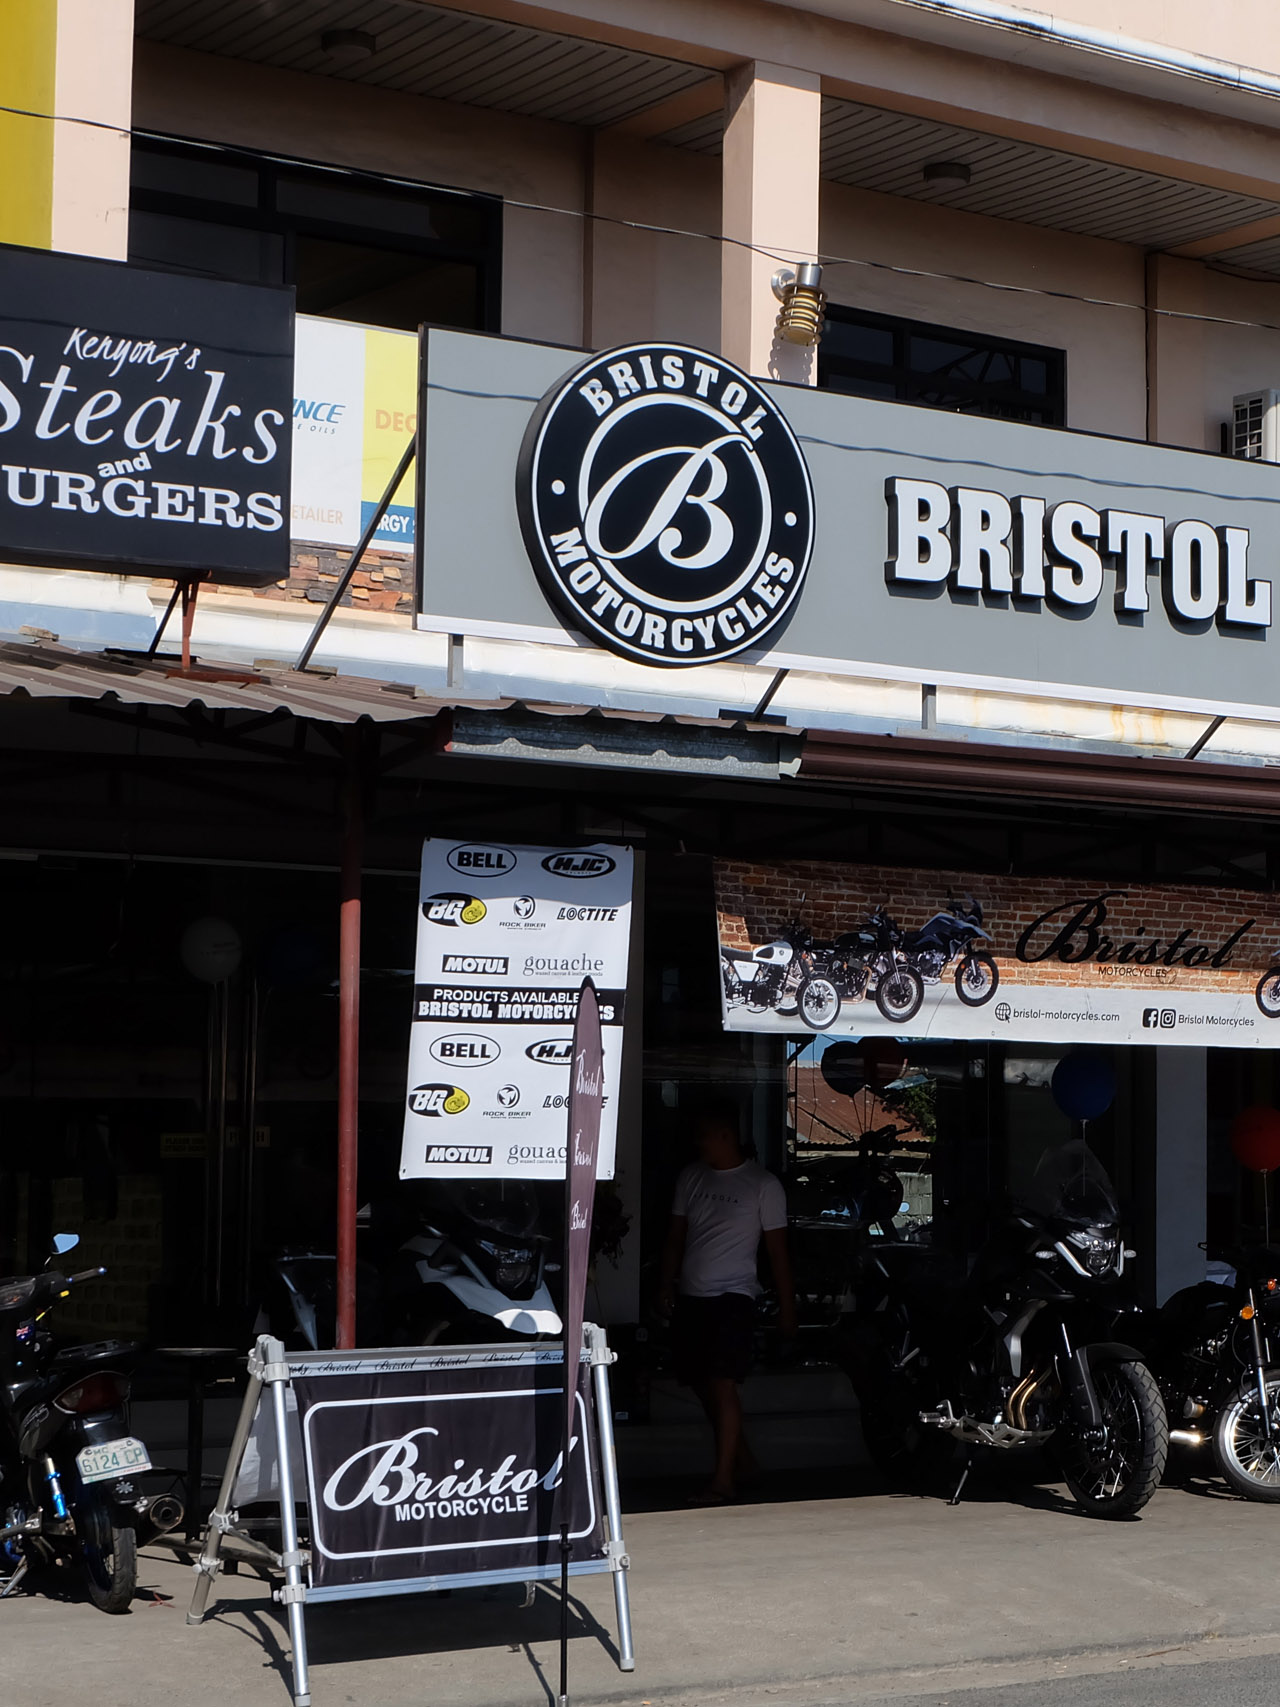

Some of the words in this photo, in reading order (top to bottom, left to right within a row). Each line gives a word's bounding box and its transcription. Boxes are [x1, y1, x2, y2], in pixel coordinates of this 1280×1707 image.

[63, 327, 201, 383] Kenyong's
[579, 354, 768, 442] BRISTOL
[97, 452, 152, 477] and
[1, 464, 284, 532] URGERS
[884, 475, 1272, 628] BRISTOL
[550, 527, 795, 652] MOTORCYCLES
[457, 851, 507, 869] BELL
[553, 857, 605, 872] HJC
[428, 899, 466, 919] BG
[557, 907, 619, 921] LOCTITE
[1015, 890, 1257, 968] Bristol
[444, 957, 507, 973] MOTUL
[522, 953, 604, 976] gouache
[1098, 966, 1168, 979] MOTORCYCLES
[433, 989, 509, 1002] PRODUCTS
[511, 991, 580, 1003] AVAILABLE
[418, 1001, 493, 1018] BRISTOL
[1013, 1008, 1120, 1022] bristol-motorcycles.com
[1178, 1013, 1205, 1026] Bristol
[1206, 1015, 1255, 1028] Motorcycles
[440, 1042, 491, 1059] BELL
[536, 1044, 573, 1058] HJ
[413, 1089, 448, 1111] BG
[428, 1147, 490, 1162] MOTUL
[323, 1426, 578, 1511] Bristol
[394, 1494, 529, 1522] MOTORCYCLE
